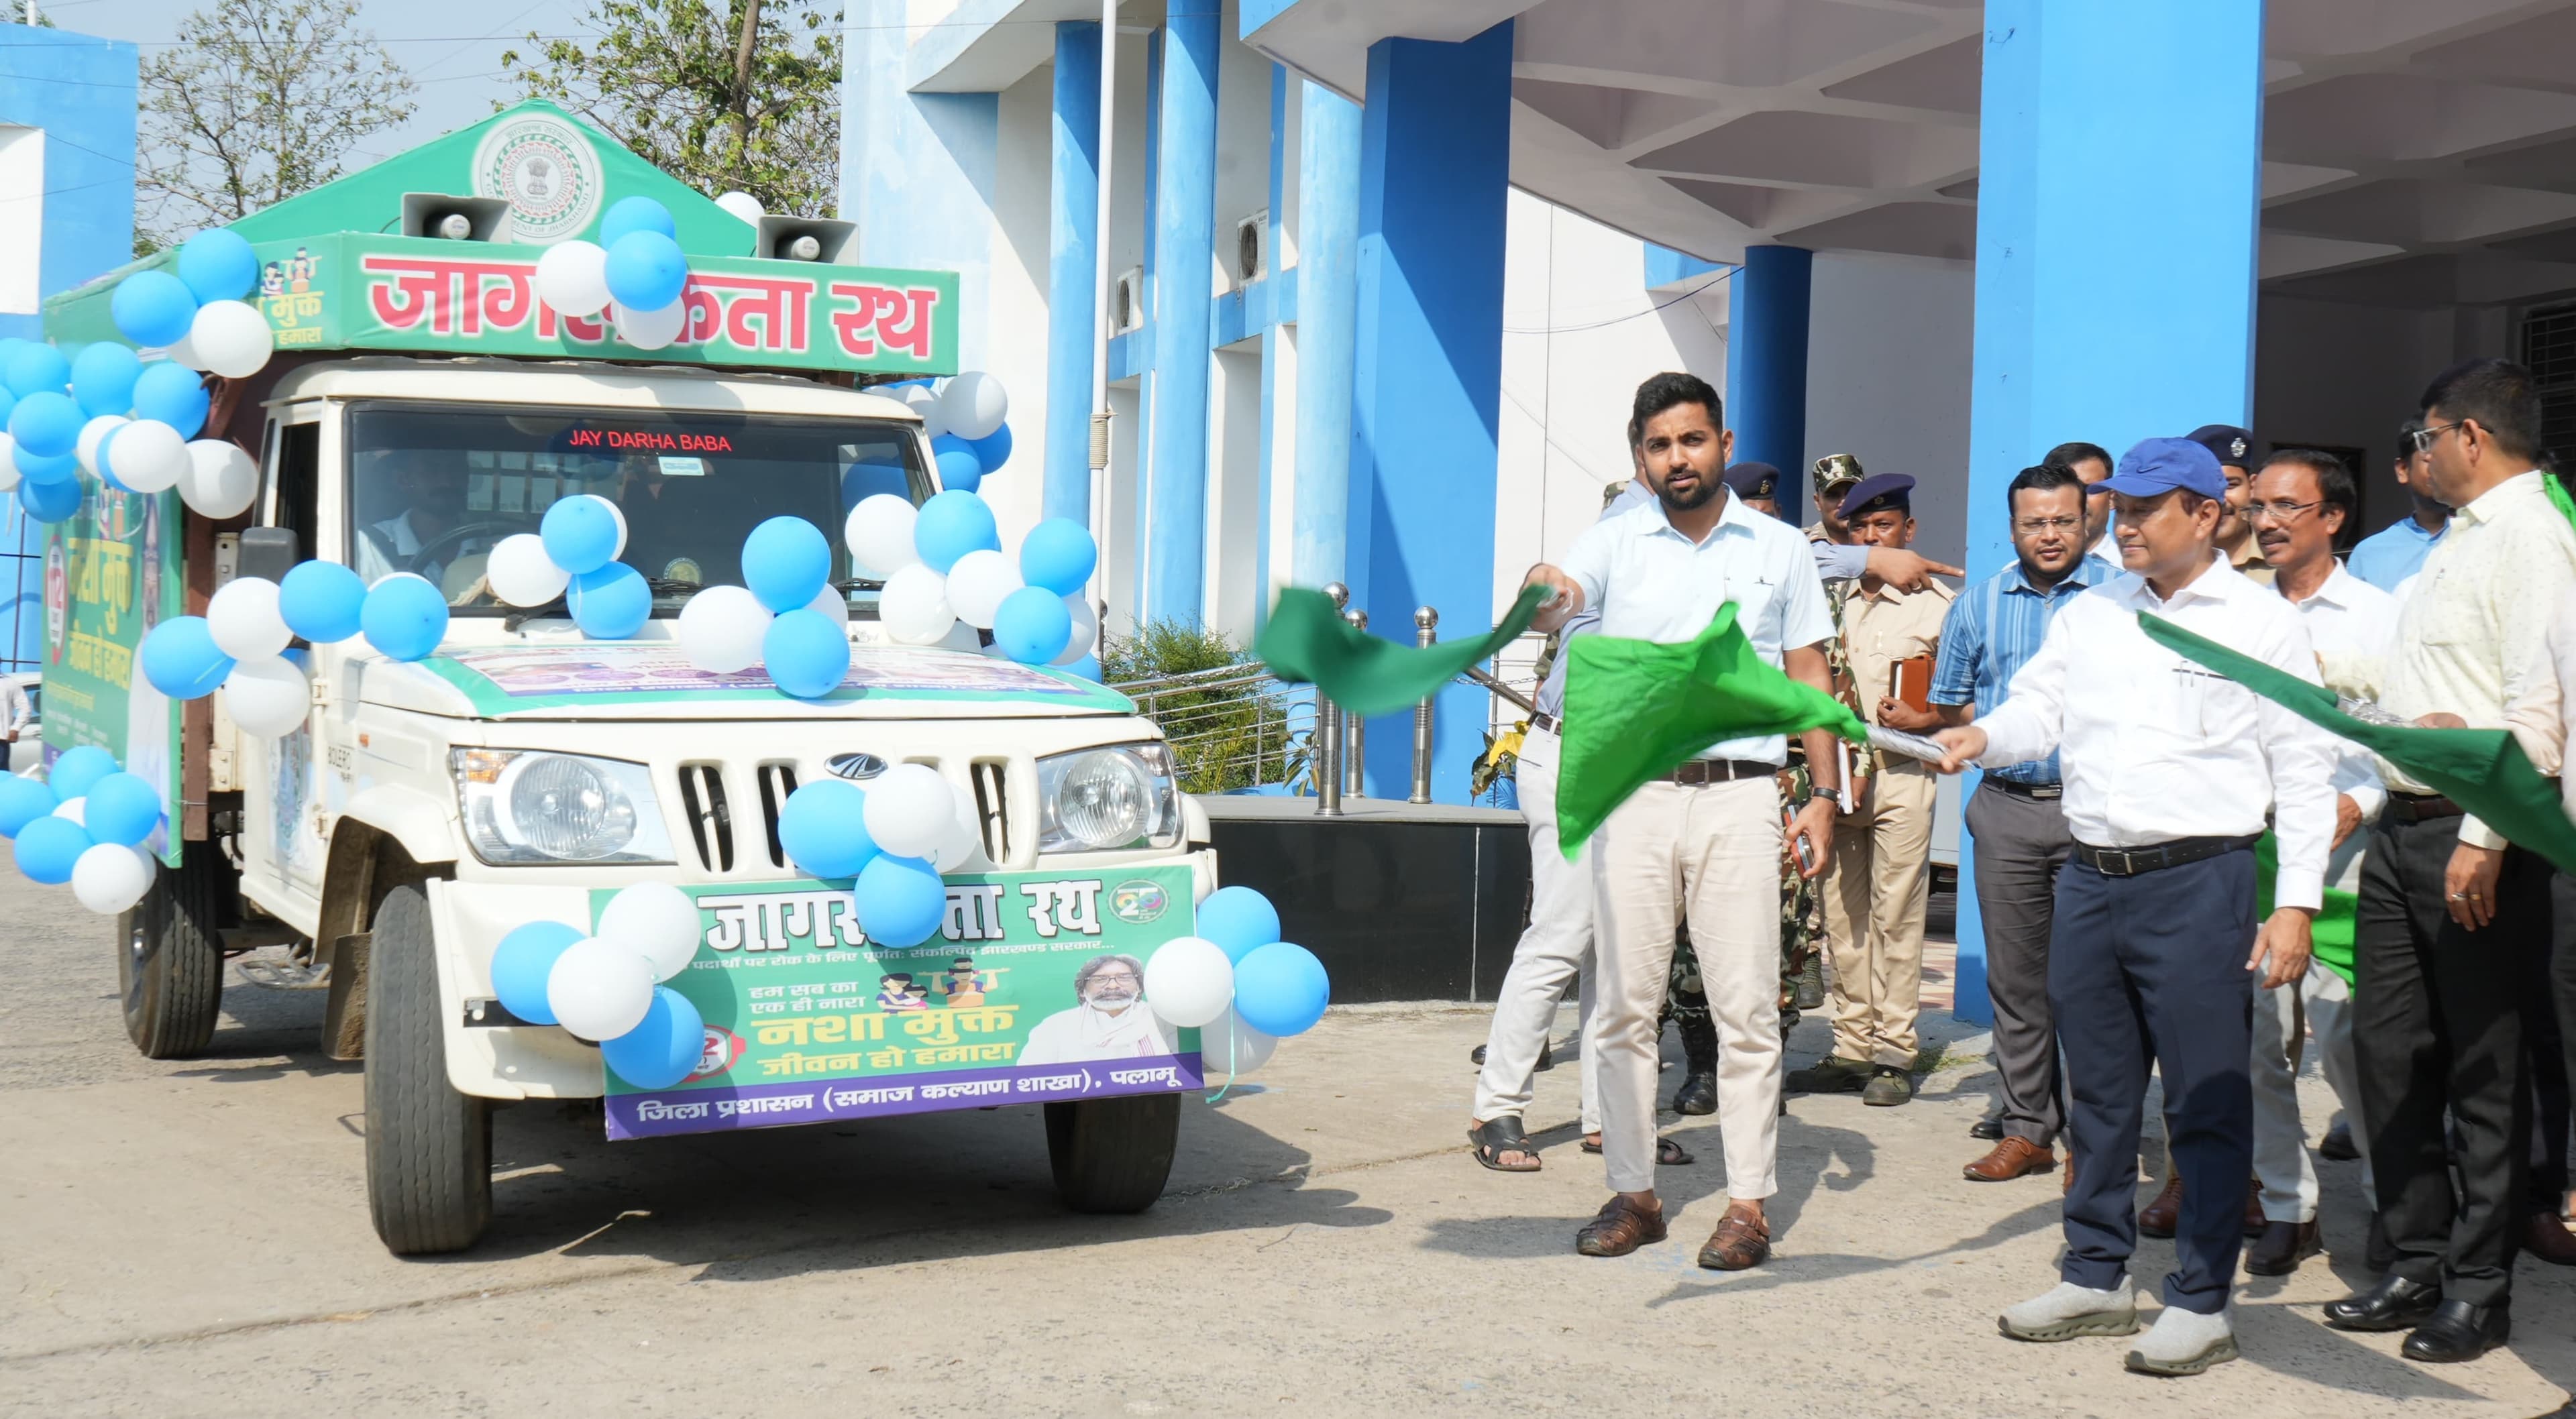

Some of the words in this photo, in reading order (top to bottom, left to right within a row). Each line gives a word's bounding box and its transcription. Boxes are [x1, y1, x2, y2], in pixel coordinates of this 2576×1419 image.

[270, 291, 325, 327] मुक्त
[832, 285, 936, 357] रथ
[278, 327, 322, 345] हमारा
[569, 430, 602, 446] JAY
[608, 431, 676, 450] DARHA
[679, 435, 733, 452] BABA
[1020, 878, 1103, 938] रथ
[744, 956, 767, 967] पर
[771, 954, 802, 966] रोक
[806, 952, 822, 964] के
[826, 951, 858, 962] लिए
[909, 946, 976, 958] संकल्पित
[749, 985, 786, 999] हम
[789, 983, 828, 997] सब
[830, 981, 859, 994] का
[749, 1001, 786, 1014] एक
[790, 998, 814, 1012] ही
[816, 997, 866, 1010] नारा
[751, 1010, 893, 1046] नशा
[896, 1005, 1020, 1045] मुक्त
[757, 1051, 861, 1076] जीवन
[867, 1046, 904, 1068] हो
[911, 1042, 1016, 1066] हमारा
[637, 1102, 708, 1123] जिला
[715, 1094, 816, 1119] प्रशासन
[823, 1086, 915, 1113] (समाज
[920, 1080, 1011, 1098] कल्याण
[1110, 1066, 1183, 1088] पलामू
